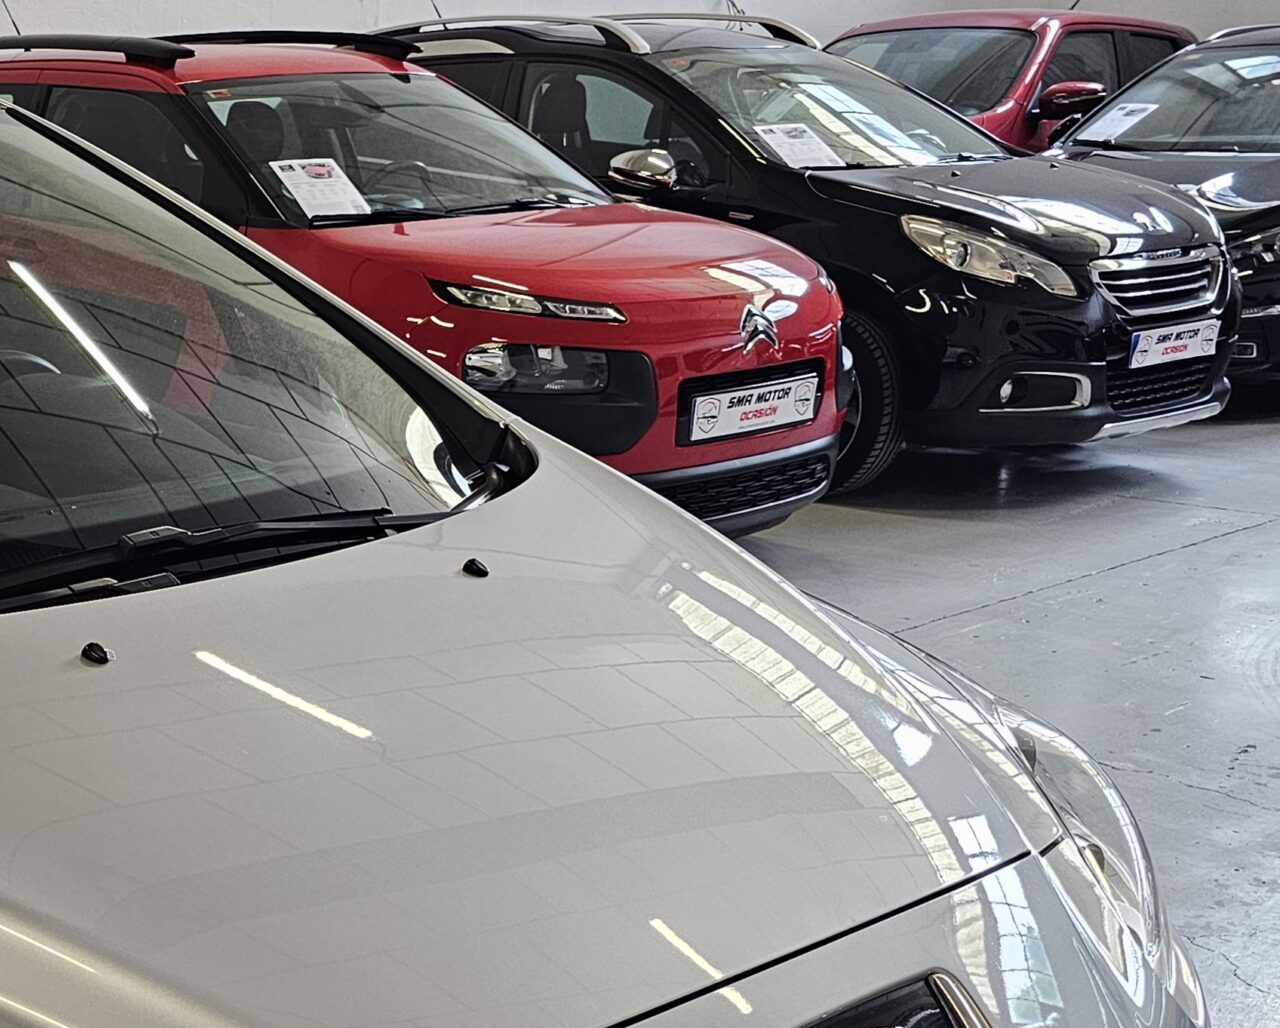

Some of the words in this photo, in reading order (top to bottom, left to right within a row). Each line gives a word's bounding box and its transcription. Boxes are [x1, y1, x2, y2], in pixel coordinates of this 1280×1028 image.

[1155, 332, 1173, 345] SMA
[1173, 328, 1201, 342] MOTOR
[727, 393, 753, 409] SMA
[754, 387, 792, 404] MOTOR
[740, 404, 778, 421] OCASIÓN
